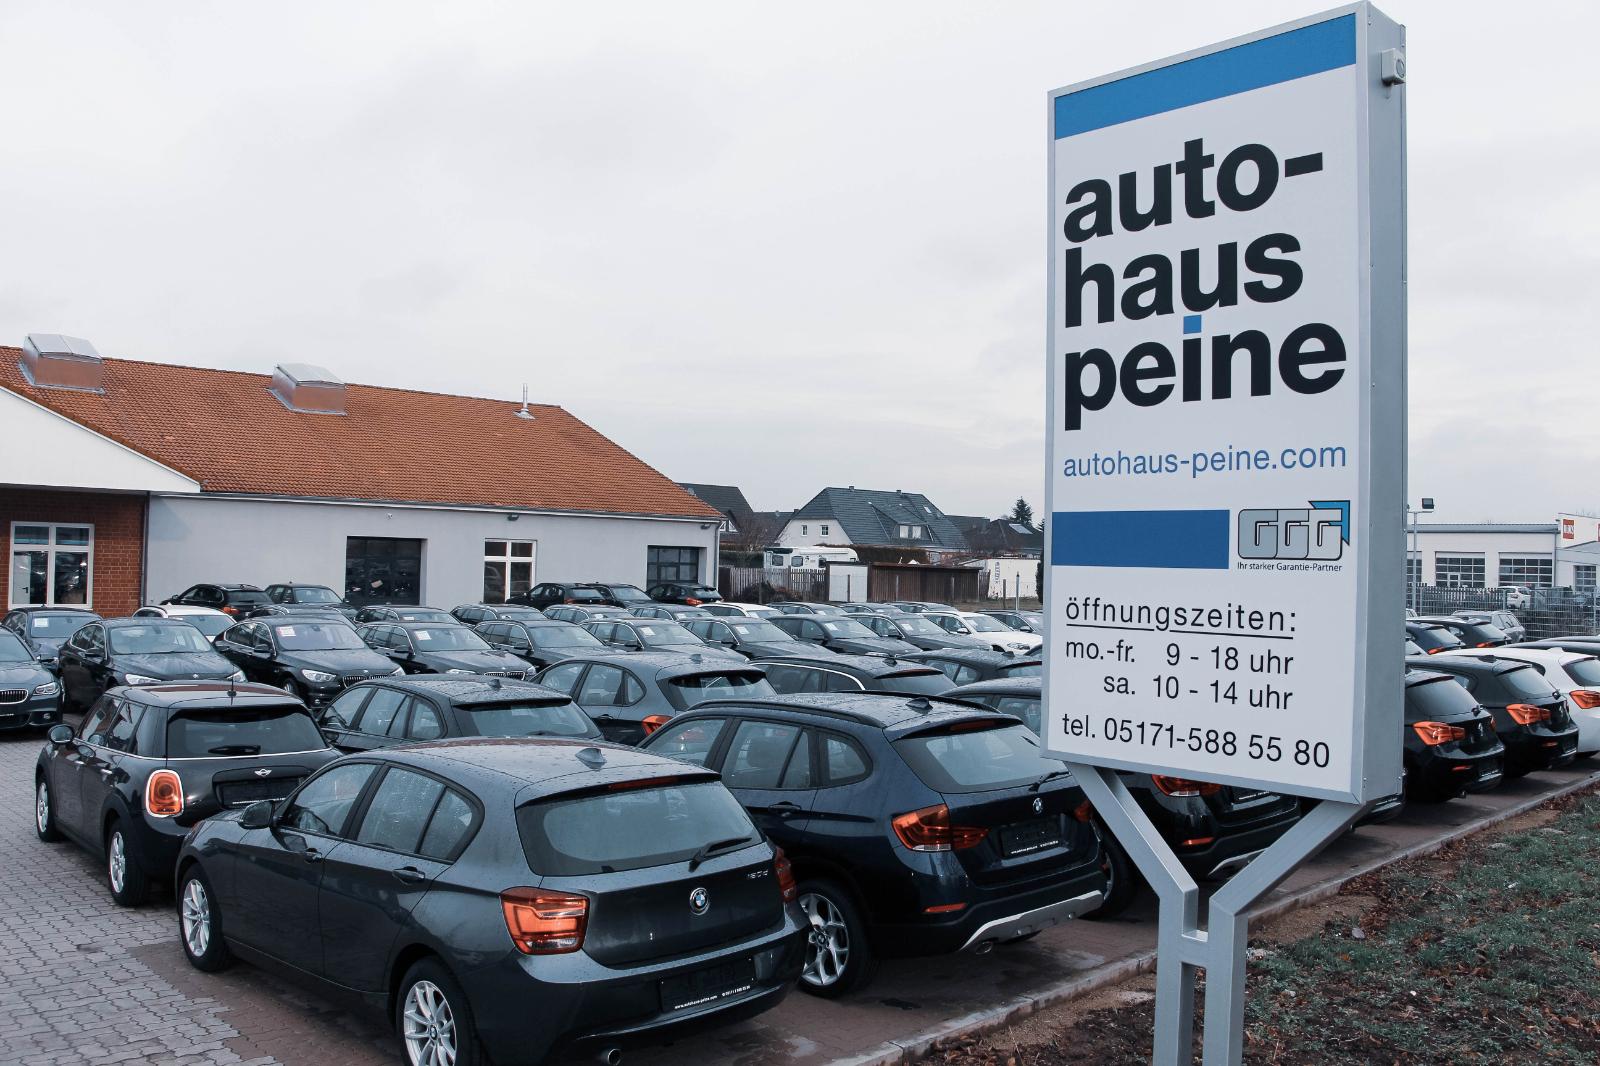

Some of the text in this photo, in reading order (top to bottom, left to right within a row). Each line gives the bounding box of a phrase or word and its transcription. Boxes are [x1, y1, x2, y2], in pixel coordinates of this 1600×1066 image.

[1063, 138, 1323, 243] auto-
[1065, 232, 1304, 328] haus
[1064, 314, 1347, 431] peine
[1063, 445, 1347, 479] autohaus-peine.com
[1238, 562, 1343, 572] Ihr starker Garantie-Partner
[1066, 597, 1297, 633] öffnungszeiten:
[1066, 640, 1136, 664] mo.-fr.
[1166, 643, 1180, 667] 9
[1211, 645, 1239, 671] 18
[1250, 649, 1294, 675] uhr
[1104, 675, 1136, 696] sa.
[1153, 675, 1180, 700] 10
[1210, 679, 1239, 705] 14
[1250, 684, 1294, 710] uhr
[1063, 713, 1330, 769] tel. 05171-588 55 80
